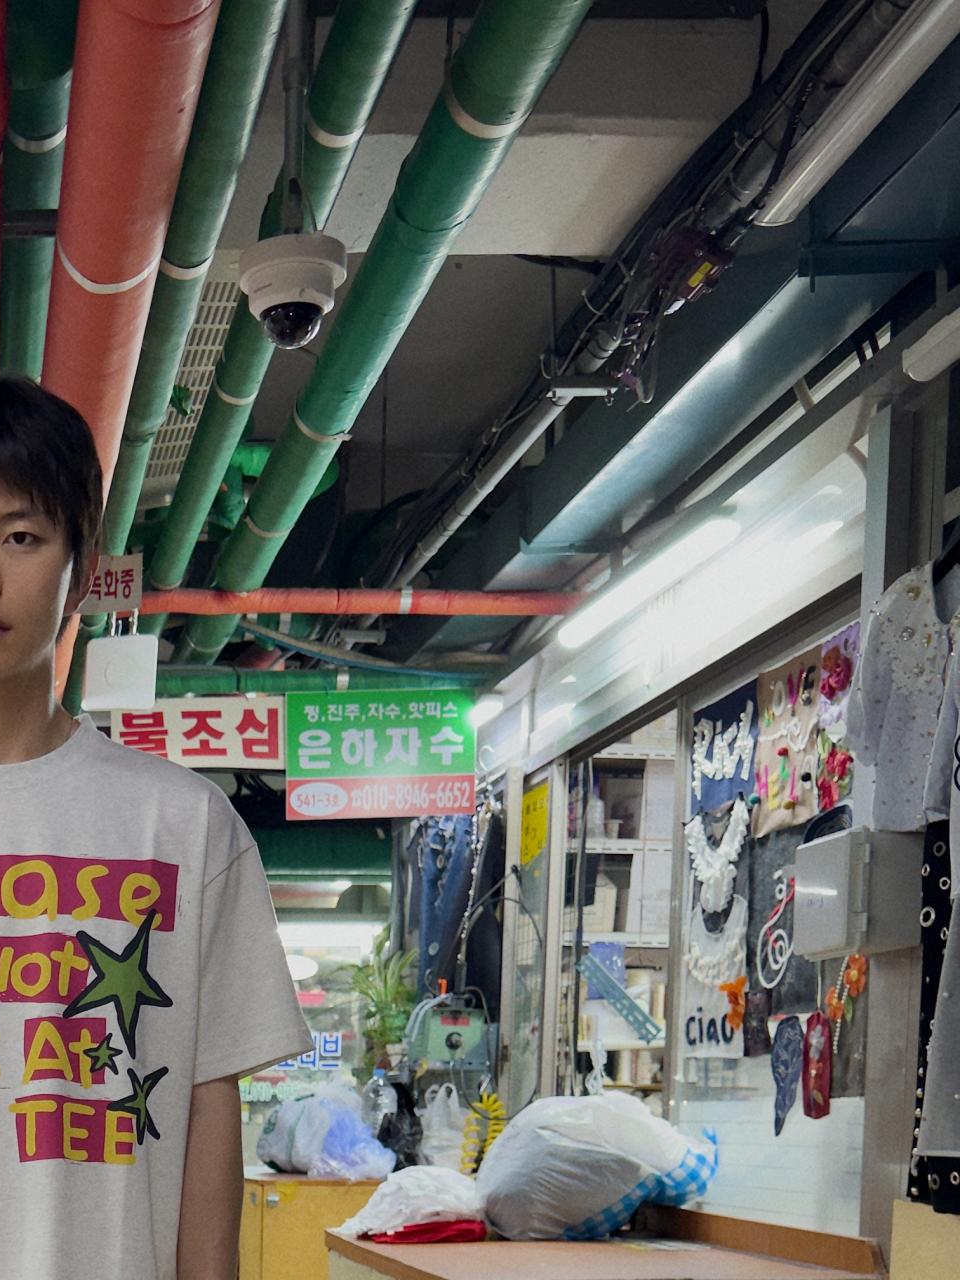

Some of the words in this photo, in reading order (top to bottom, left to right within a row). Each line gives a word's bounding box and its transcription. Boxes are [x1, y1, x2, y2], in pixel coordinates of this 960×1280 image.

[119, 708, 279, 760] 불조심
[298, 726, 464, 769] 은하자수
[8, 1099, 137, 1166] TEE
